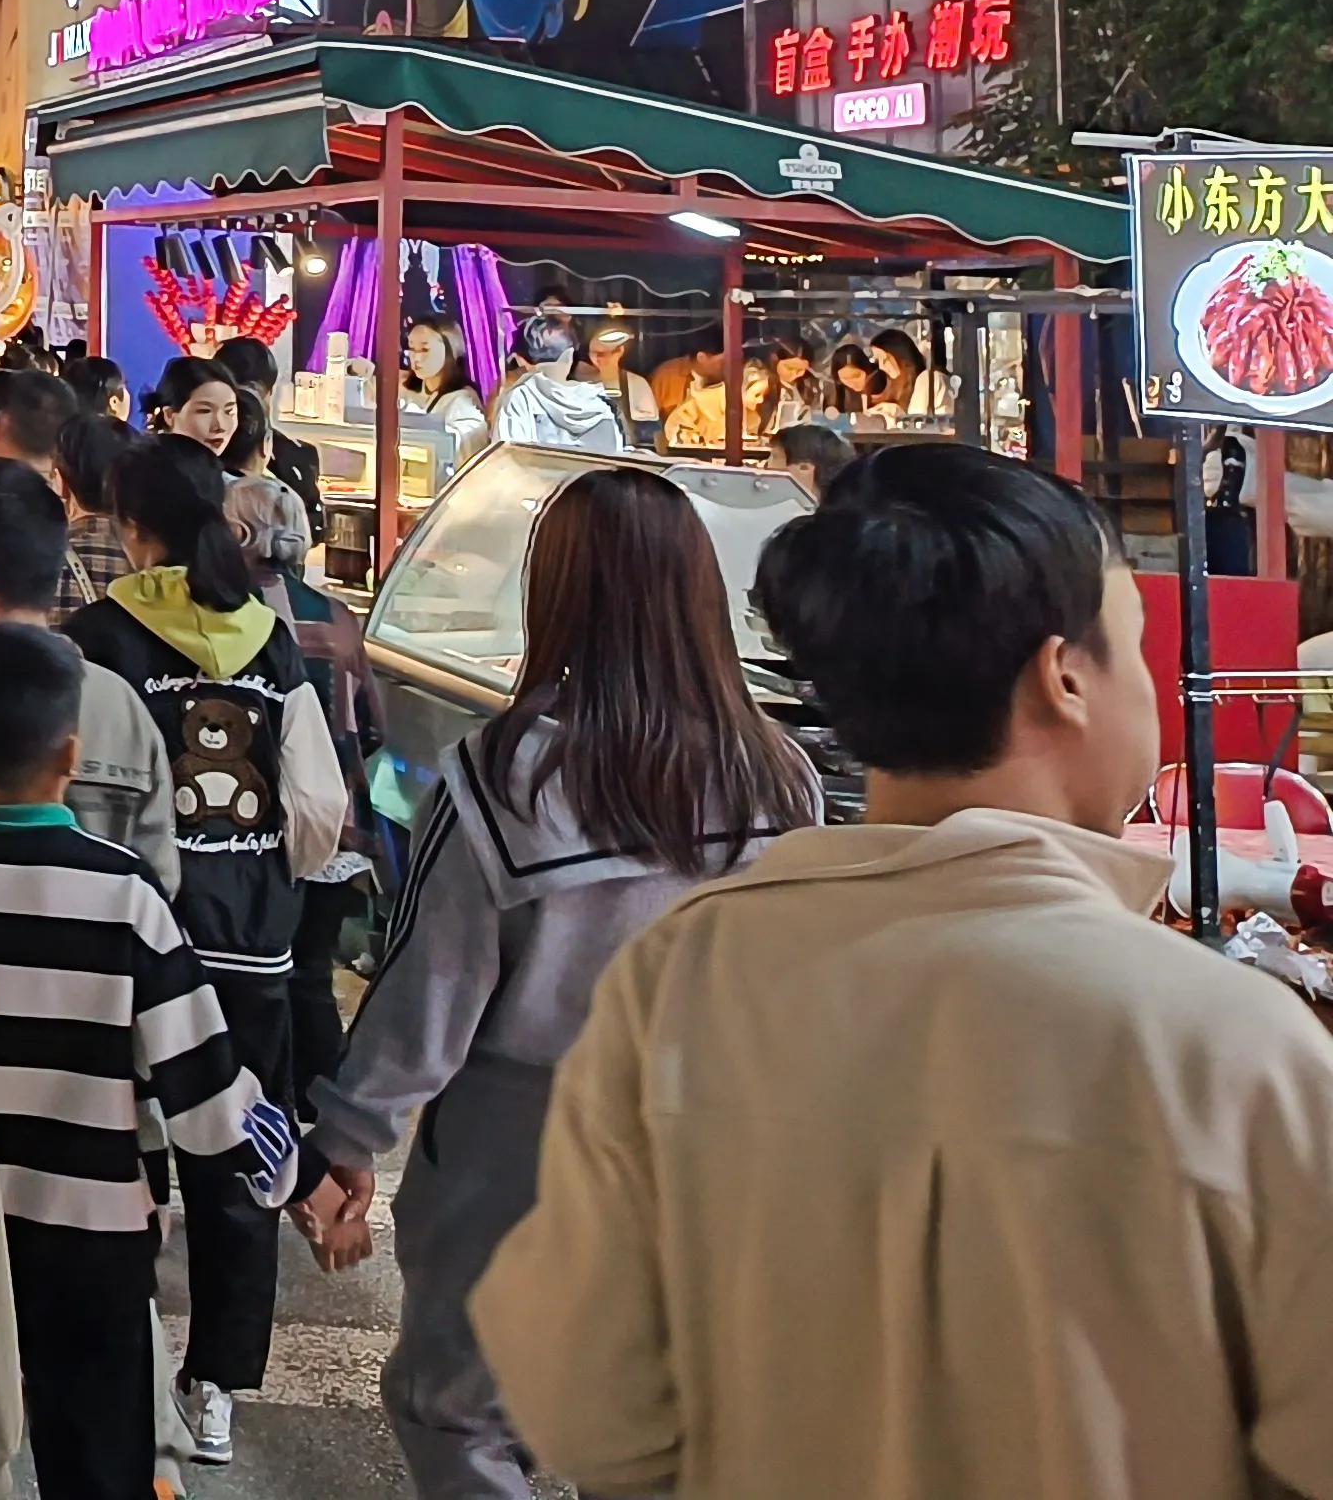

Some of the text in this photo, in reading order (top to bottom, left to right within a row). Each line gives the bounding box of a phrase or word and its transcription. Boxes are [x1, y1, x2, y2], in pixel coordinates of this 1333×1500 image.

[774, 26, 834, 96] 盲盒
[847, 10, 911, 83] 手办
[1157, 164, 1333, 236] 小东方大
